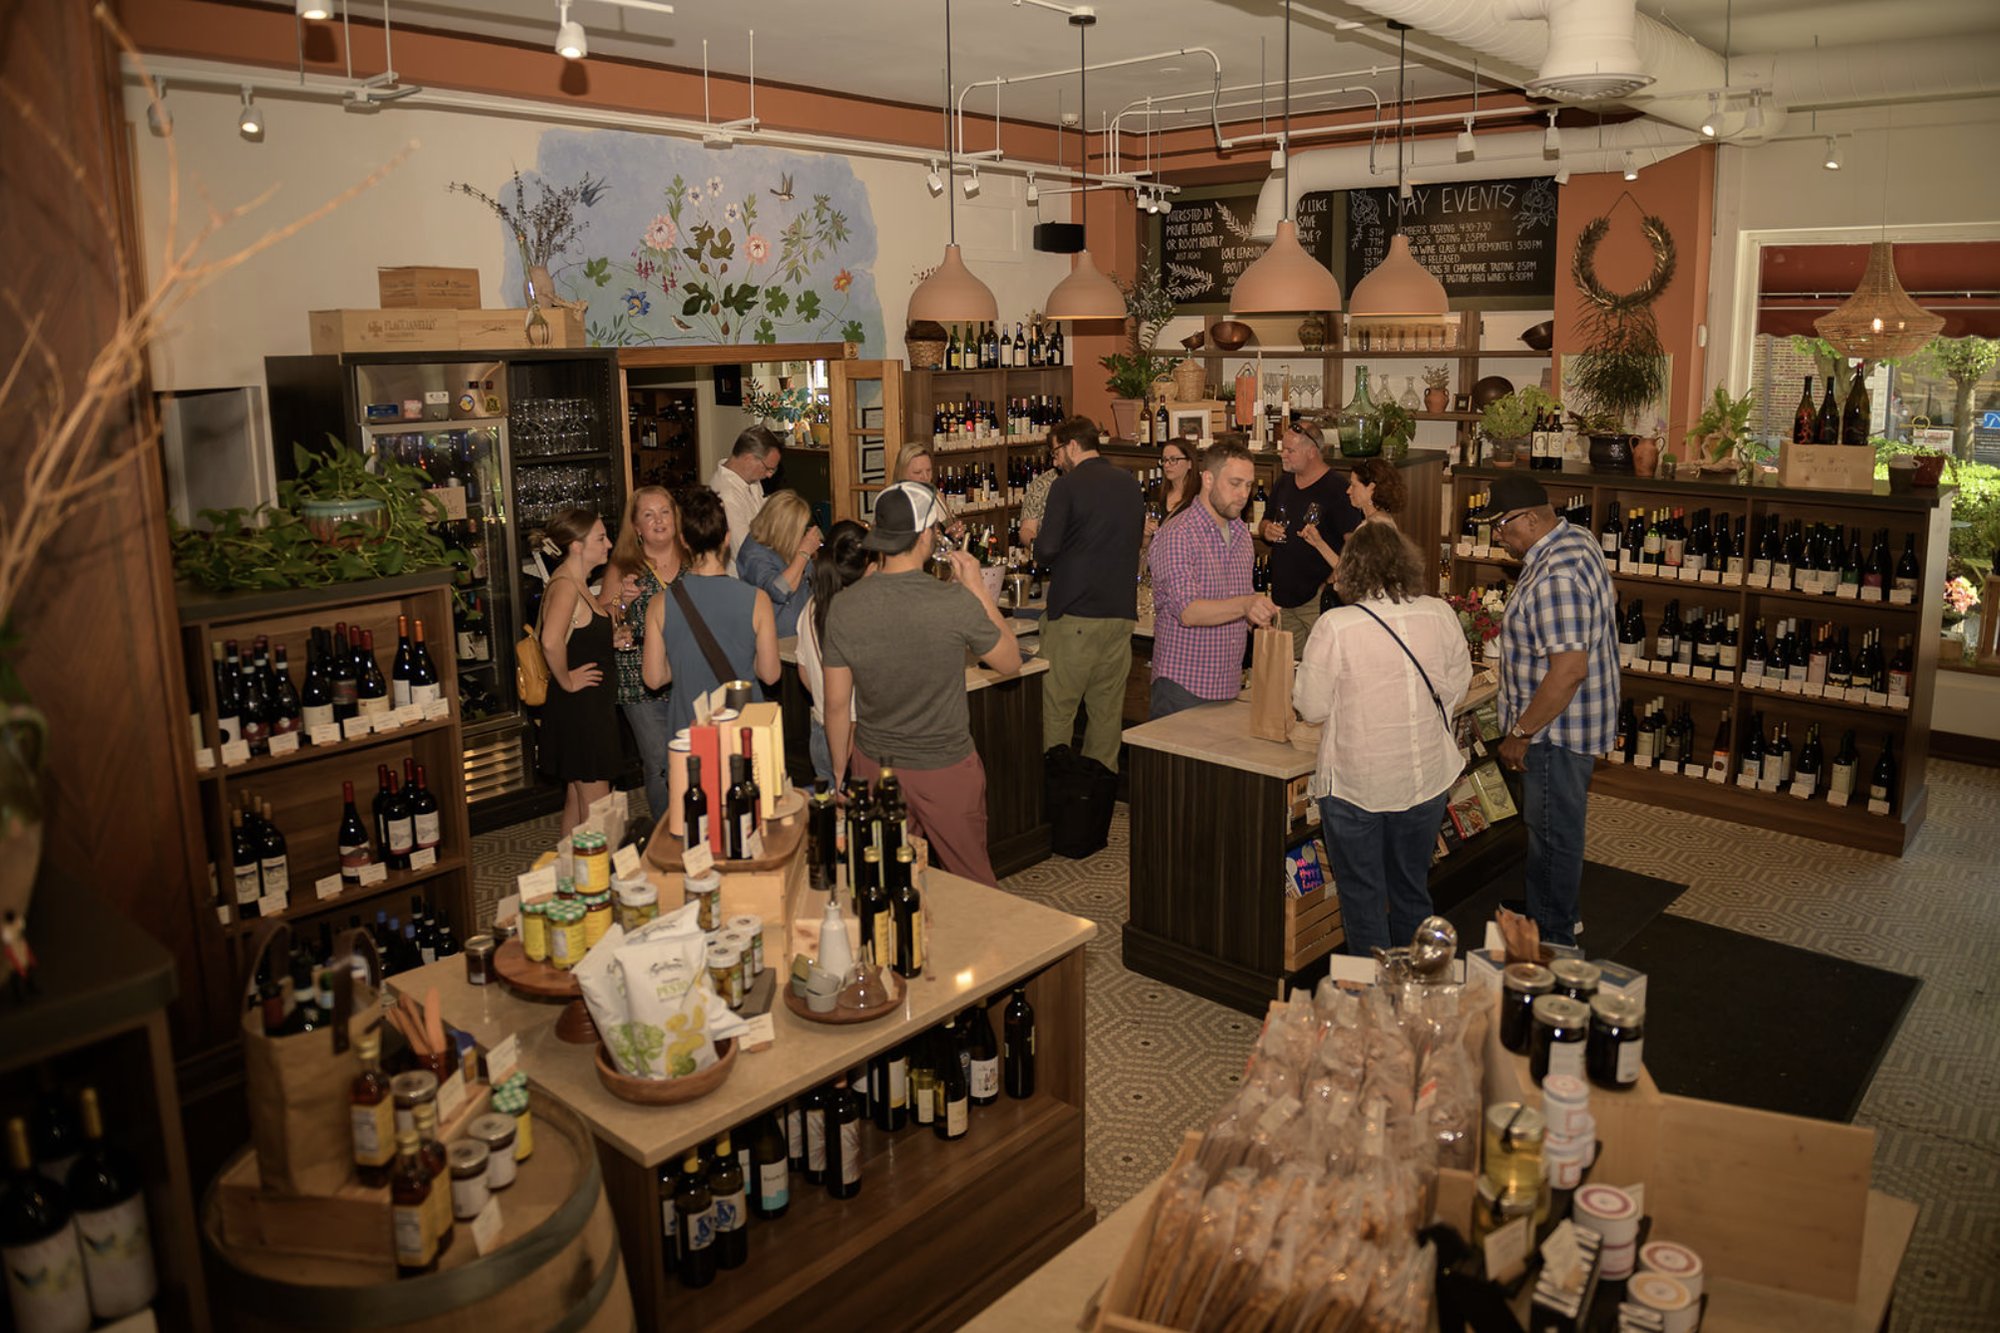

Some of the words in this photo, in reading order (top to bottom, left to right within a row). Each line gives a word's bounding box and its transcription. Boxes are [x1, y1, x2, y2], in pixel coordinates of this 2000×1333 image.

[1307, 198, 1328, 212] LIKE
[1441, 184, 1517, 214] EVENTS
[1369, 227, 1385, 237] 5TH
[1429, 223, 1455, 234] TASTING
[1166, 238, 1177, 250] OR
[1178, 237, 1198, 250] ROOM
[1368, 237, 1385, 247] 7TH
[1435, 233, 1460, 243] TASTING
[1221, 247, 1236, 260] LOVE
[1419, 244, 1436, 254] WINE
[1459, 243, 1475, 253] ALTO
[1428, 253, 1461, 264] RELEASED
[1222, 261, 1242, 274] ABOUT
[1452, 263, 1487, 274] CHAMPAGNE
[1490, 262, 1515, 272] TASTING
[1446, 273, 1470, 284] TASTING
[1471, 273, 1486, 283] BBQ
[1487, 272, 1506, 282] WINES
